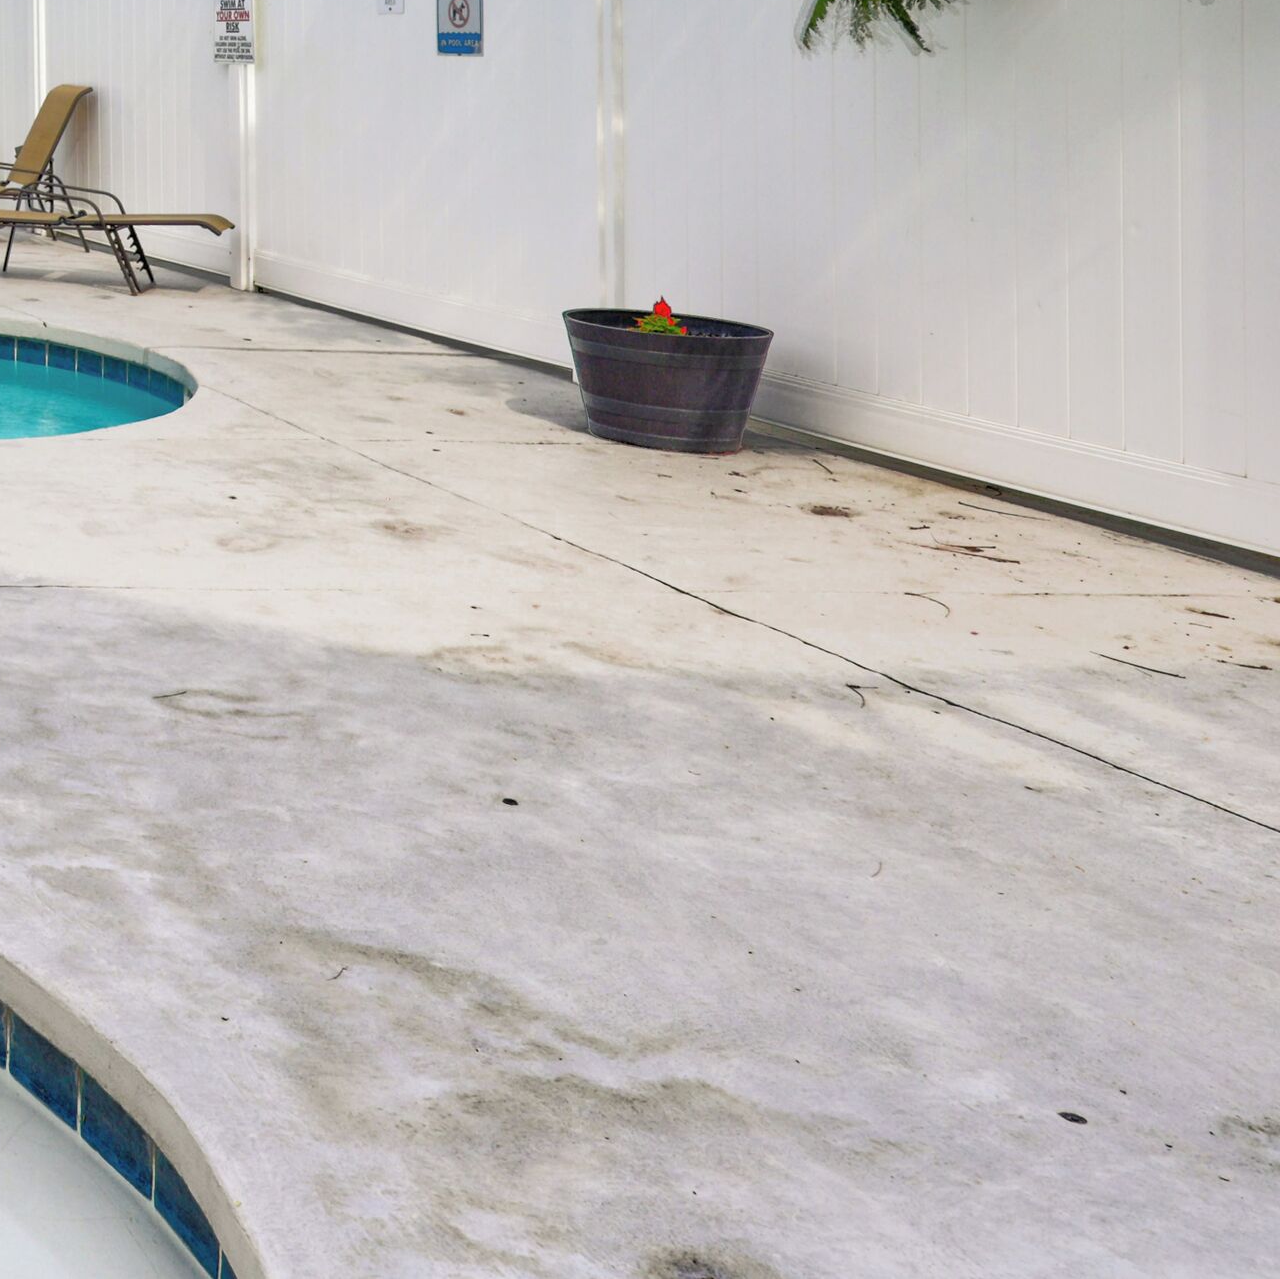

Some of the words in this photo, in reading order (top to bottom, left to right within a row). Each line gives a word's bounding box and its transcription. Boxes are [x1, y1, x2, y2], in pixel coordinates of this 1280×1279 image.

[220, 0, 236, 9] SWIM
[237, 0, 245, 9] AT
[216, 11, 232, 20] YOUR
[233, 10, 250, 20] OWN
[225, 22, 240, 31] RISK
